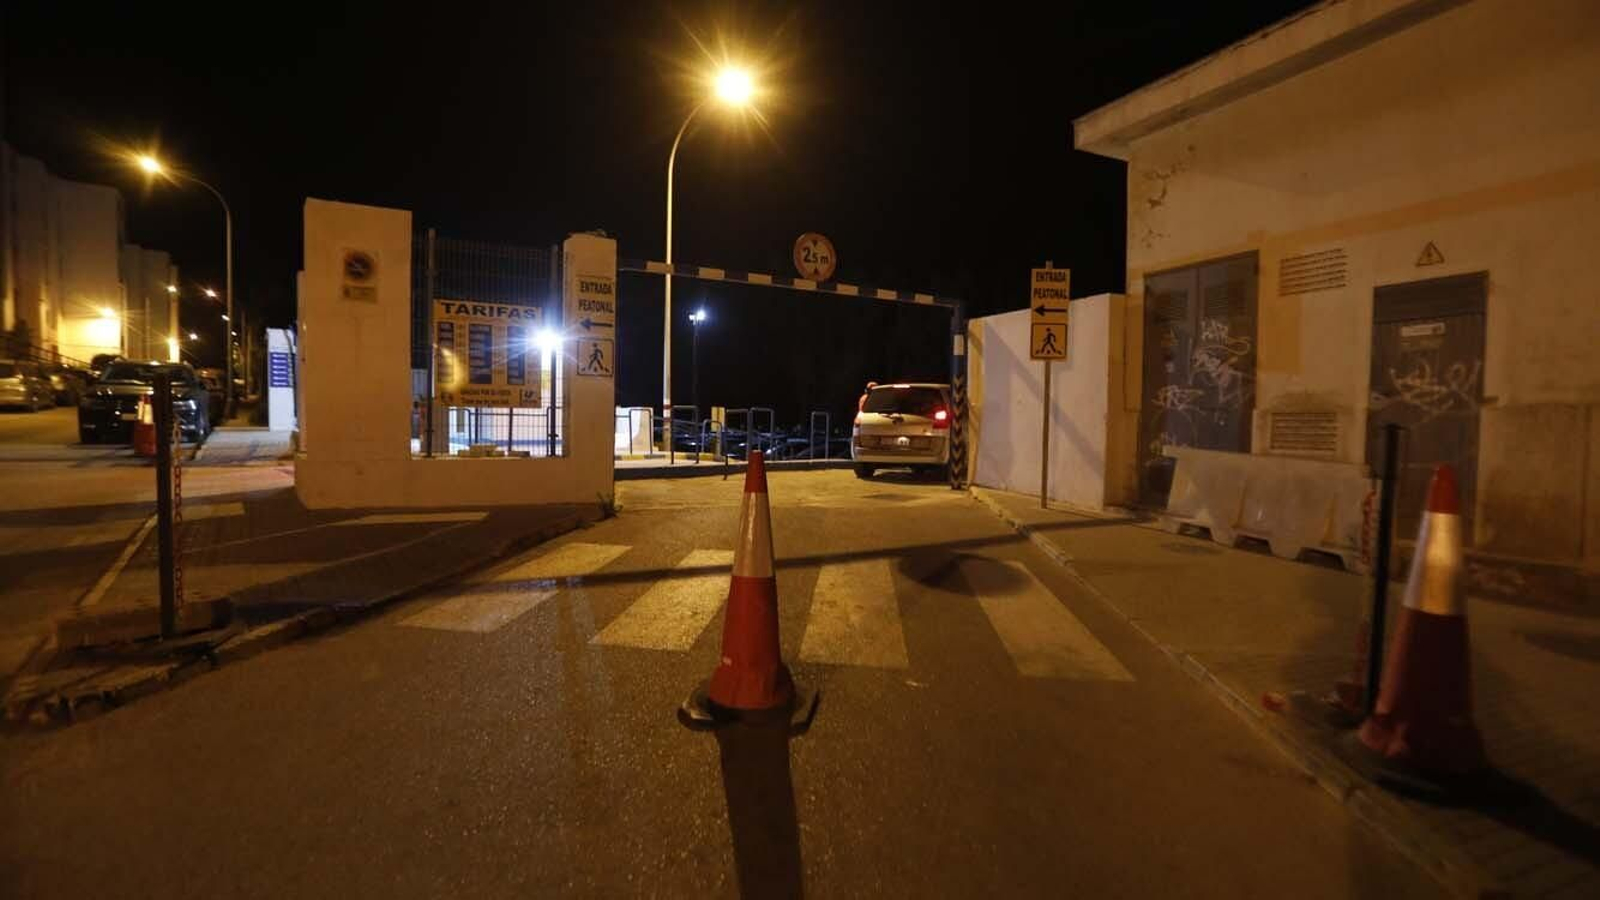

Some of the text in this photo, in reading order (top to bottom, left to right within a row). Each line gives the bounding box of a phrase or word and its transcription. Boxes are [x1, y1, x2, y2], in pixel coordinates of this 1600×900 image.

[1035, 271, 1066, 282] ENTRADA
[580, 281, 612, 294] ENTRADA
[1033, 287, 1068, 299] PEATONAL
[440, 302, 537, 319] TARIFAS
[578, 298, 614, 313] PEATONAL
